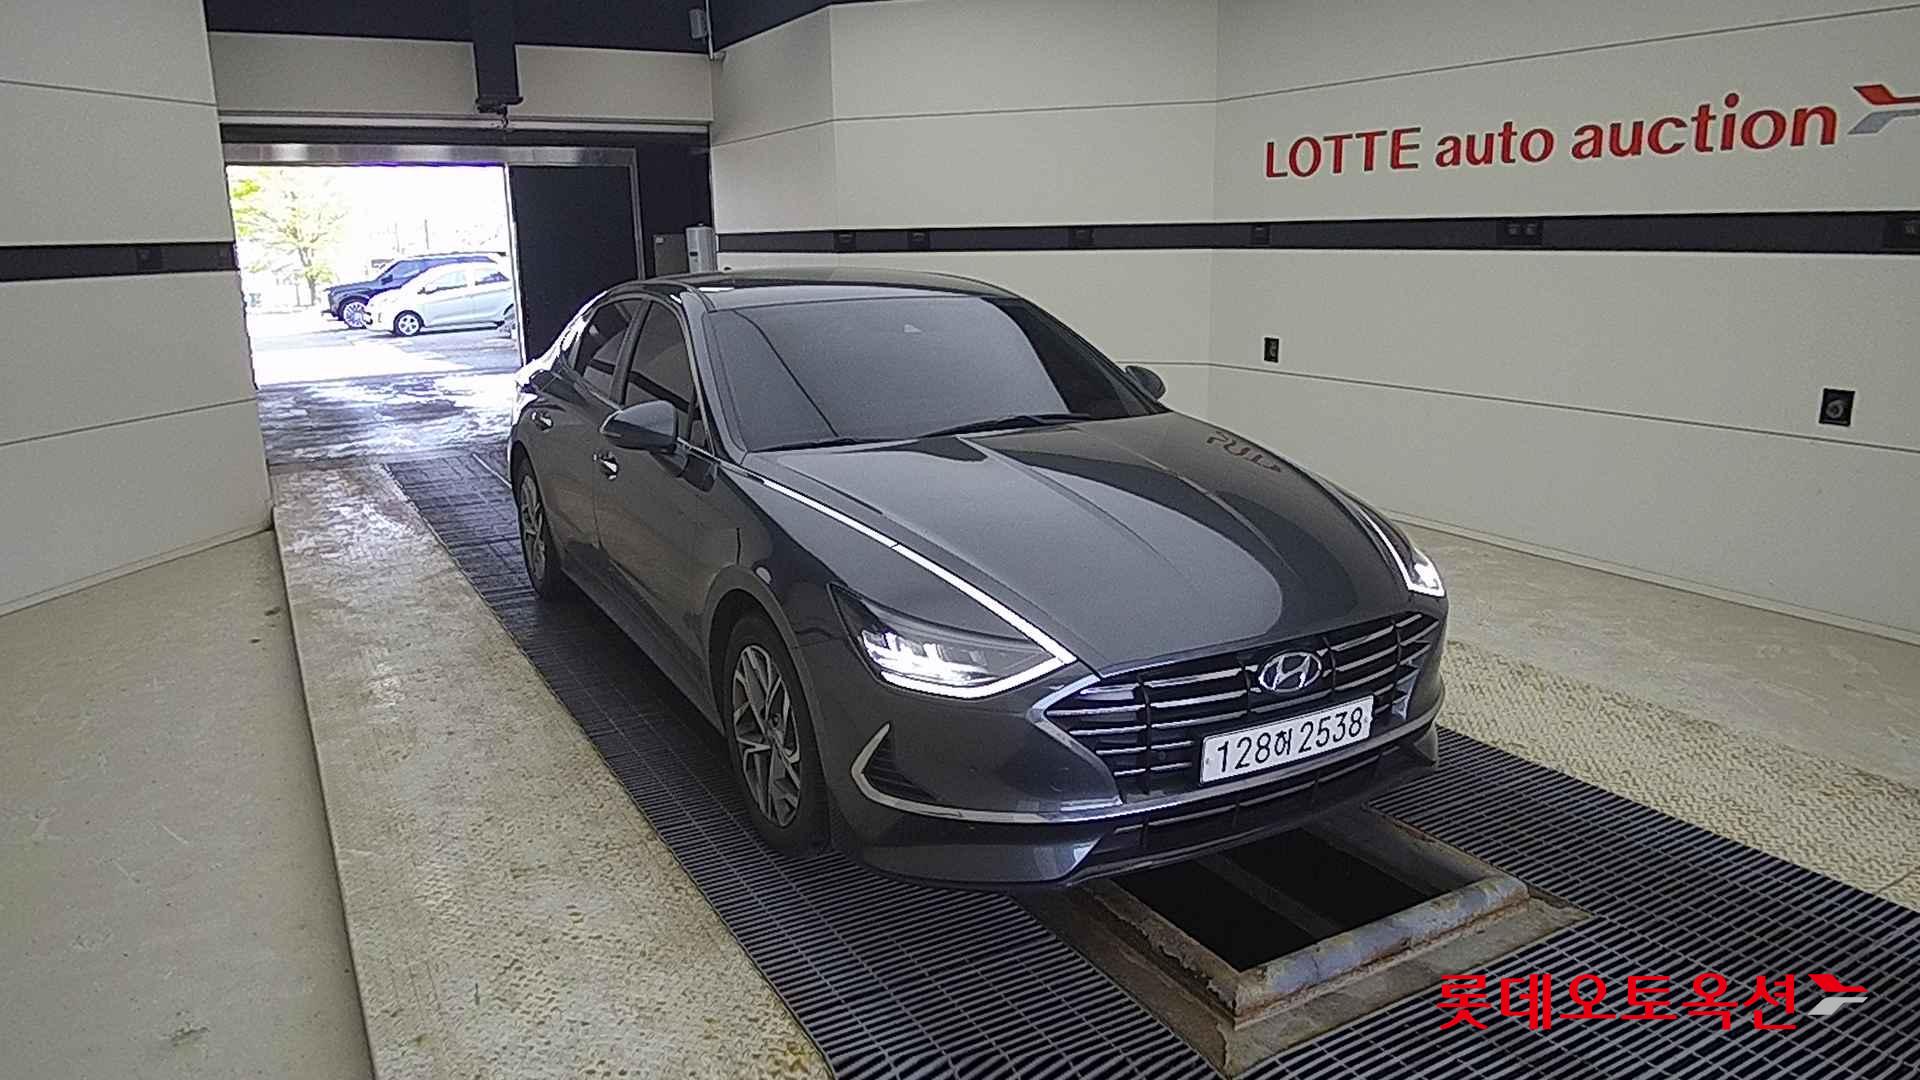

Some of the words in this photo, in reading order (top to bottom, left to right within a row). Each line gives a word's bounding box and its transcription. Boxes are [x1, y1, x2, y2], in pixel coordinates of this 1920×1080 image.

[1265, 127, 1421, 178] LOTTE
[1434, 120, 1555, 168] auto
[1571, 93, 1838, 159] auction
[1217, 727, 1293, 773] 128허
[1298, 706, 1364, 754] 2538
